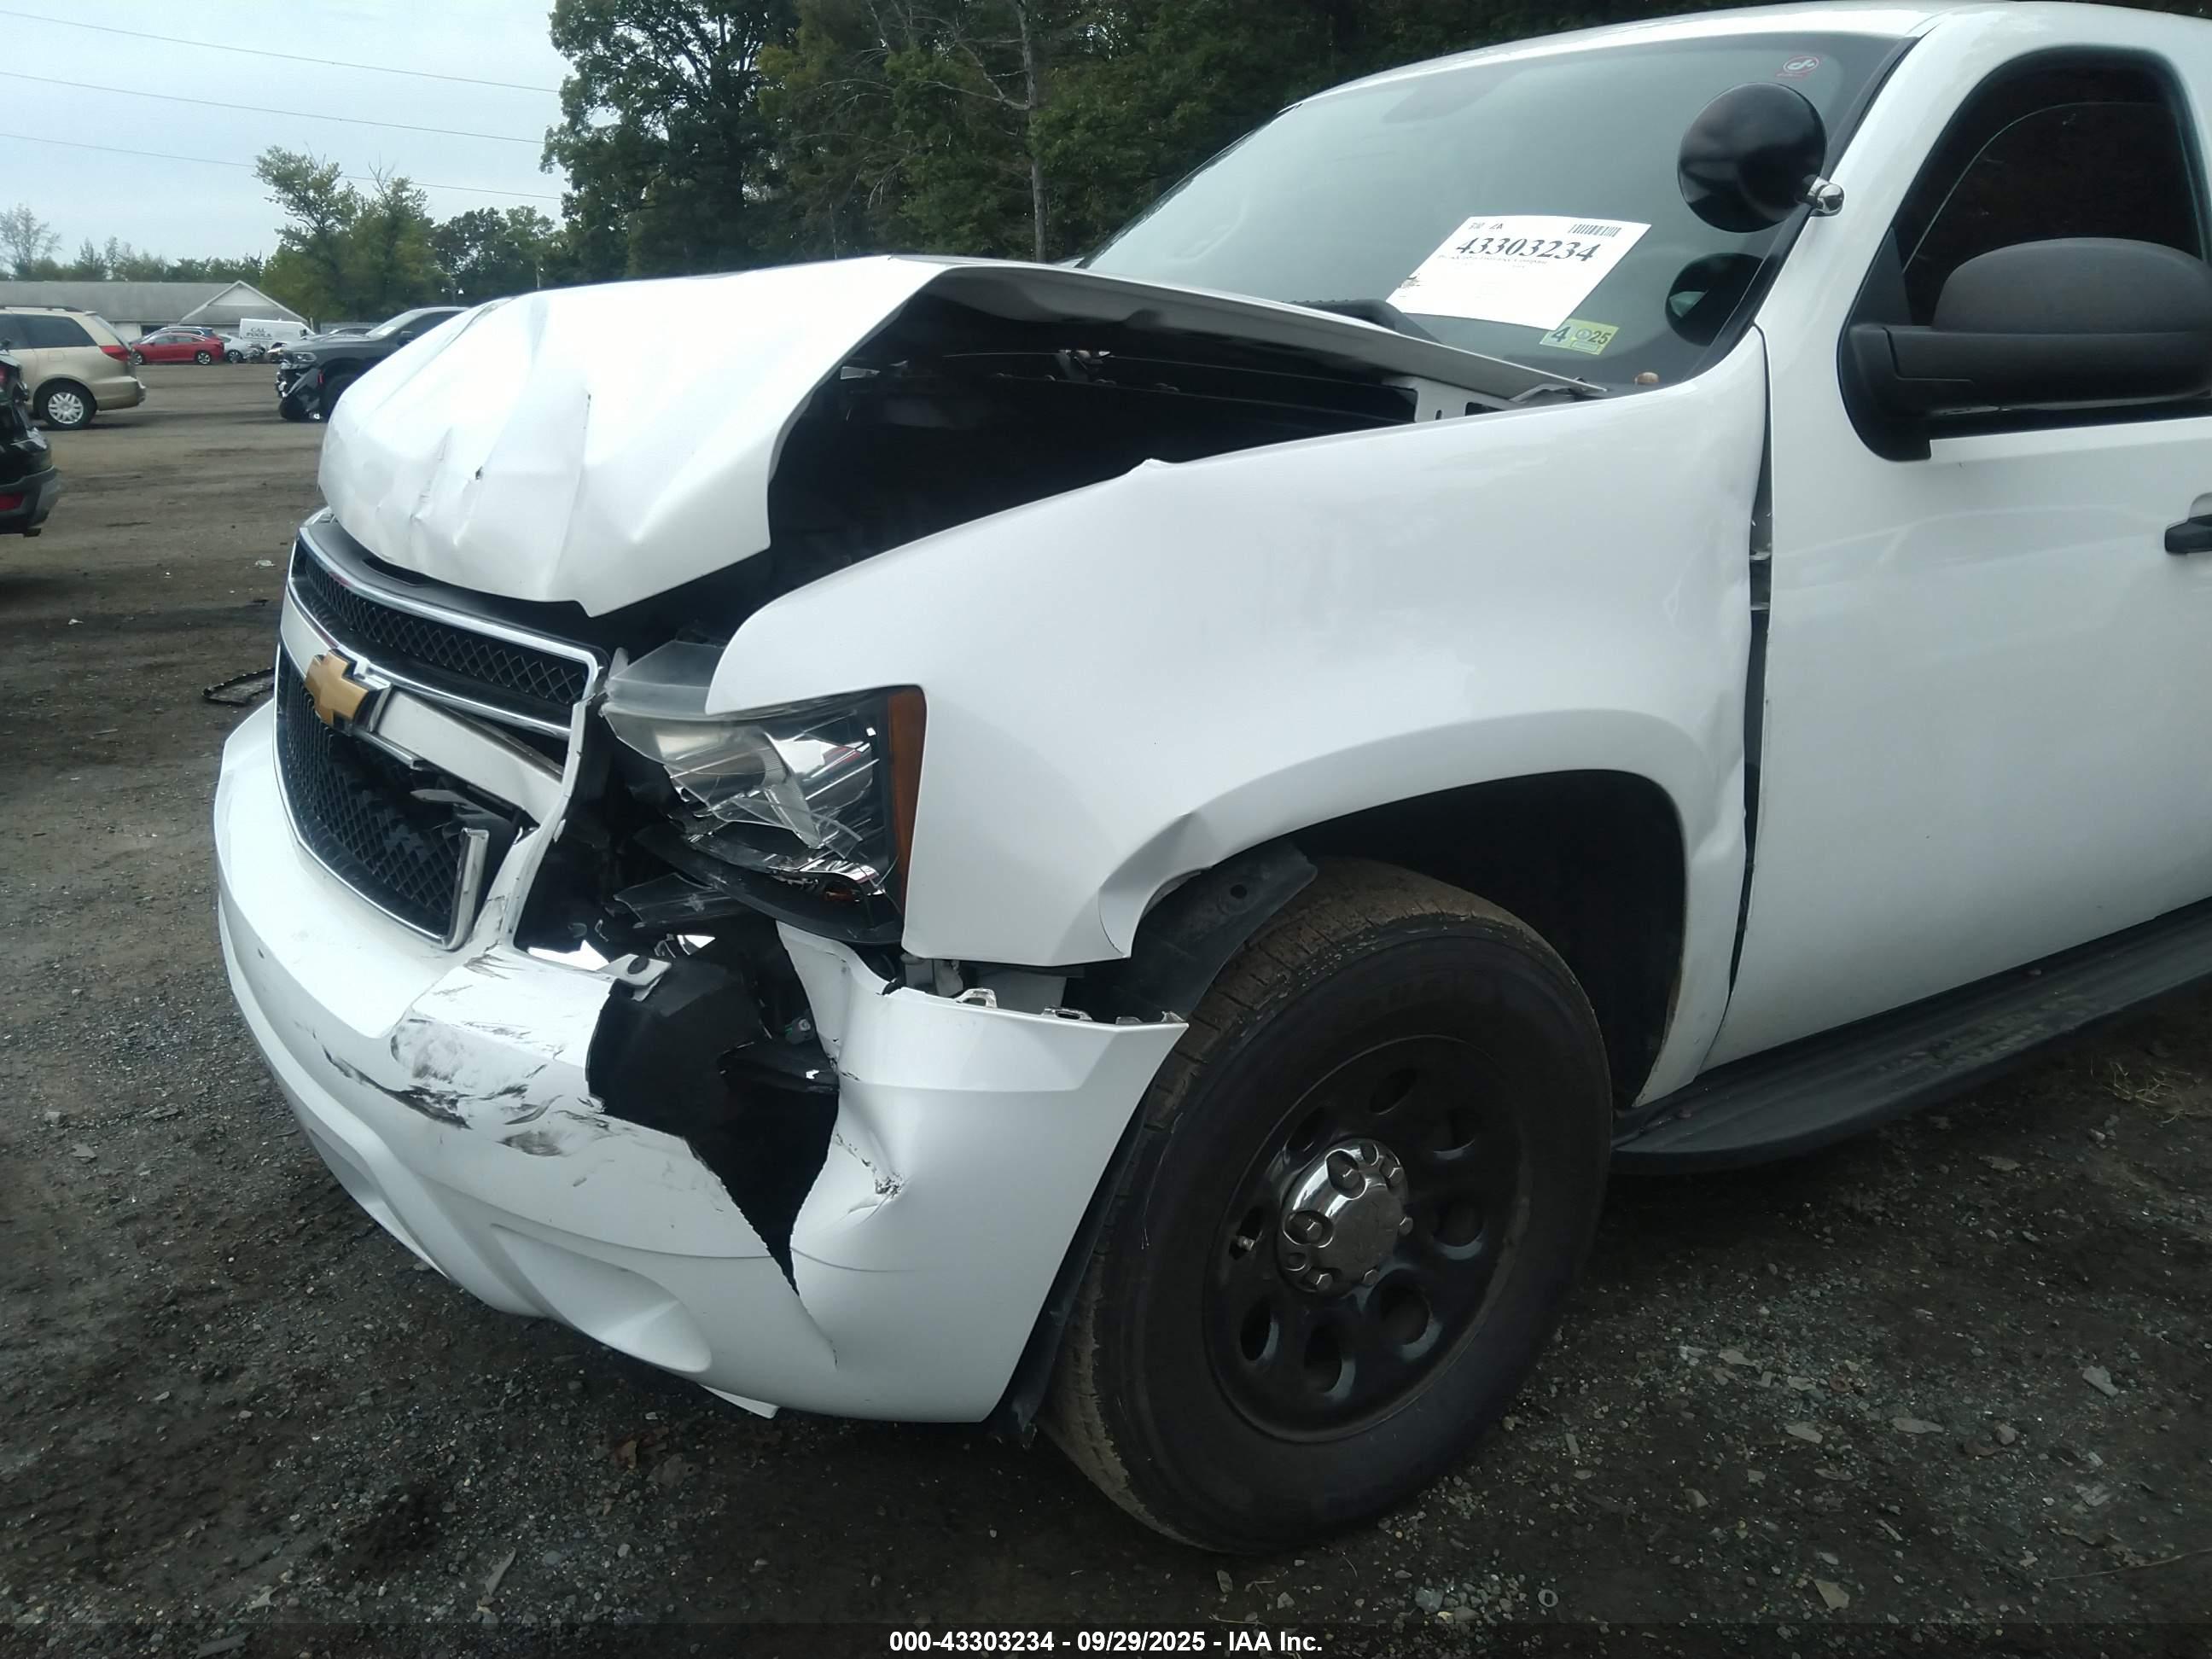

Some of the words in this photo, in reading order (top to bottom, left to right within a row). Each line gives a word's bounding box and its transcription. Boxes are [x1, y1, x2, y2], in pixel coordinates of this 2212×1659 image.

[1454, 237, 1602, 262] 43303234
[1550, 326, 1571, 342] 4
[1586, 330, 1612, 345] 25
